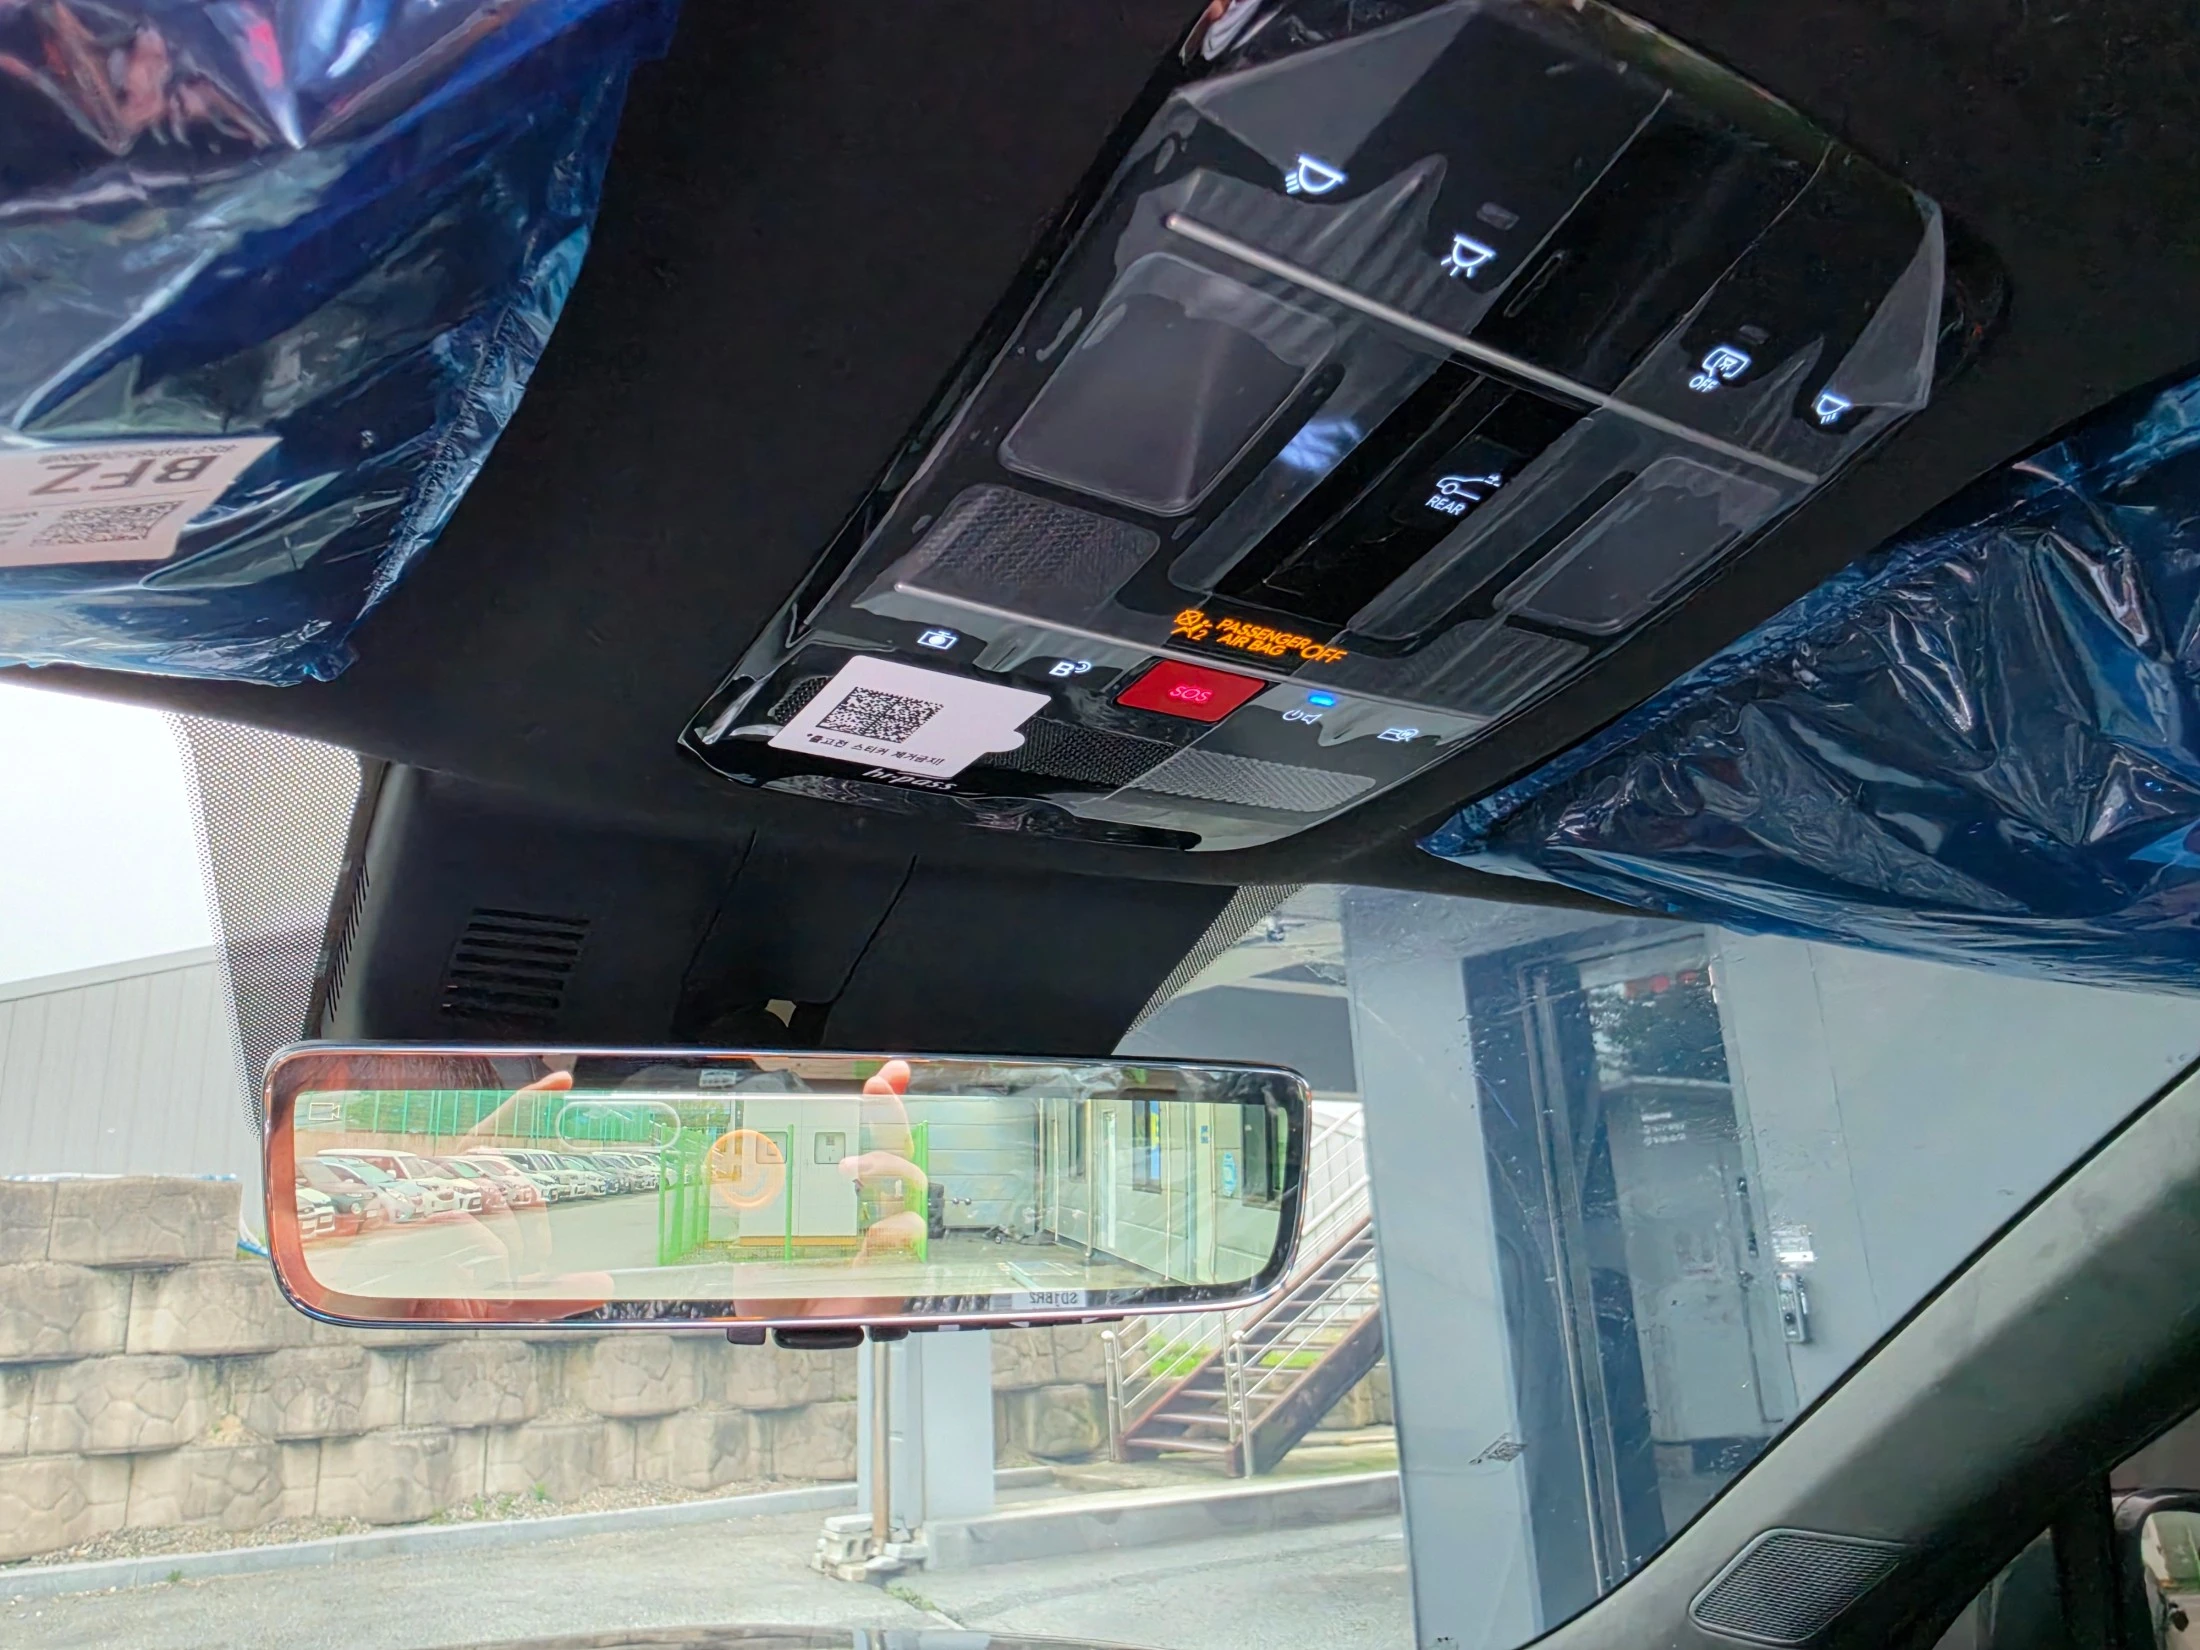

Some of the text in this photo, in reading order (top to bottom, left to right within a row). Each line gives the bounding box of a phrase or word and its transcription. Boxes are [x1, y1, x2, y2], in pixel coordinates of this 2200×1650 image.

[1689, 376, 1719, 392] OFF
[29, 455, 220, 496] BFZ
[1425, 495, 1465, 514] REAR
[1217, 619, 1312, 649] PASSENGER
[1217, 634, 1285, 656] AIR BAG
[1301, 645, 1348, 663] OFF
[1170, 686, 1211, 702] SOS
[851, 742, 890, 756] 스티커
